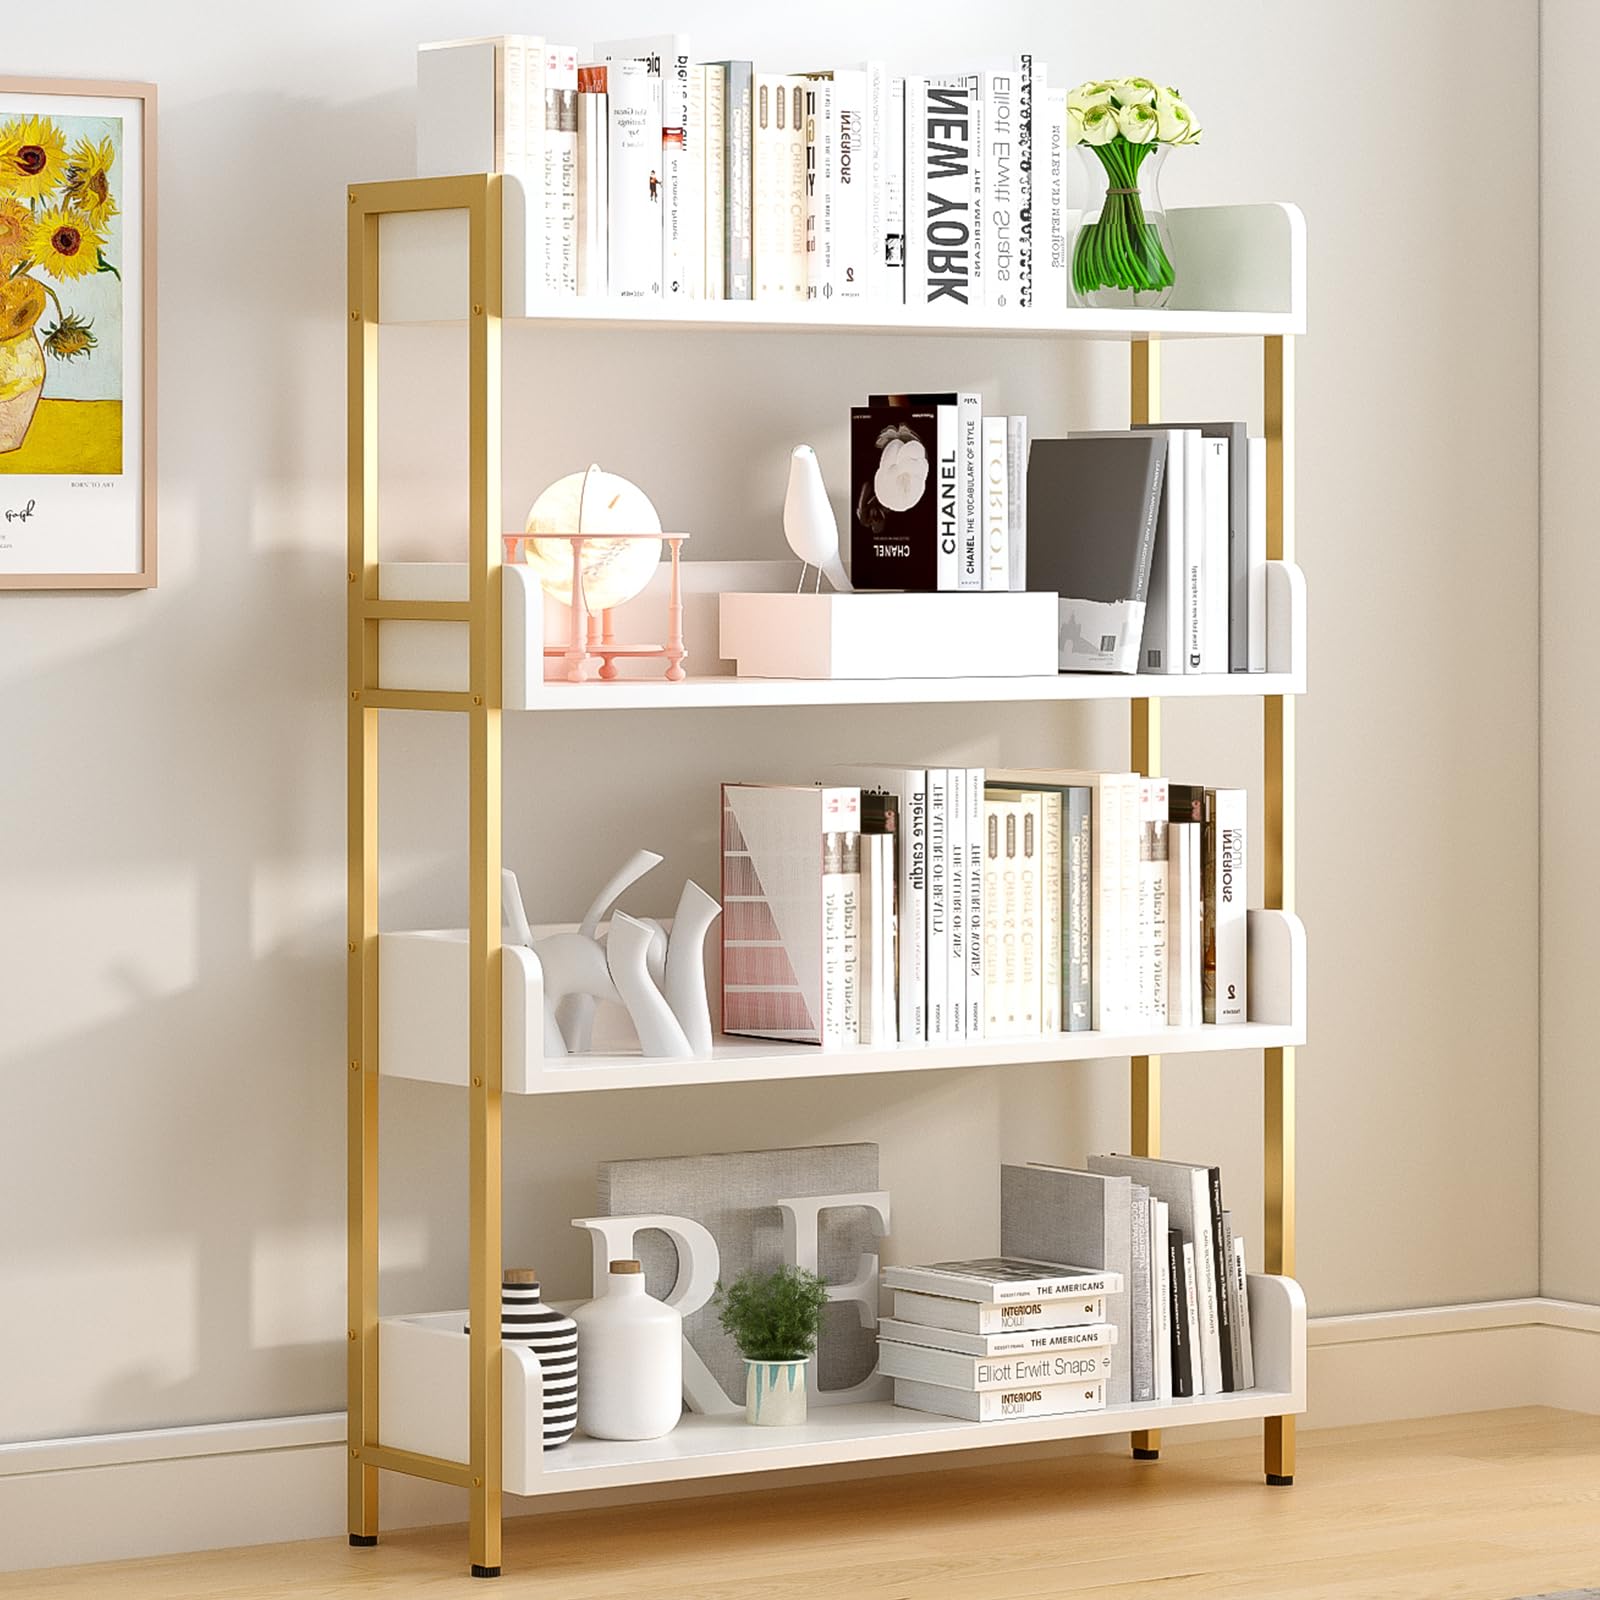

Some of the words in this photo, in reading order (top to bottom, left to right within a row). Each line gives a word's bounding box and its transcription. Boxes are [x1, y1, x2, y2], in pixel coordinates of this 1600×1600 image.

[966, 421, 975, 446] STYLE
[966, 447, 975, 459] OF
[966, 461, 975, 517] VOCABULARY
[941, 450, 956, 555] CHANEL
[966, 518, 975, 533] THE
[873, 545, 910, 557] CHANEL
[966, 535, 975, 574] CHANEL
[1037, 1285, 1053, 1295] THE
[1055, 1281, 1104, 1293] AMERICANS
[1001, 1304, 1042, 1317] INTERIORS
[1084, 1304, 1093, 1312] 2
[1031, 1338, 1047, 1347] THE
[1049, 1333, 1098, 1345] AMERICANS
[978, 1364, 1011, 1383] Elliott
[1016, 1360, 1051, 1379] Erwitt
[1054, 1357, 1096, 1376] Snaps
[1001, 1391, 1042, 1404] INTERIORS
[1084, 1391, 1093, 1399] 2
